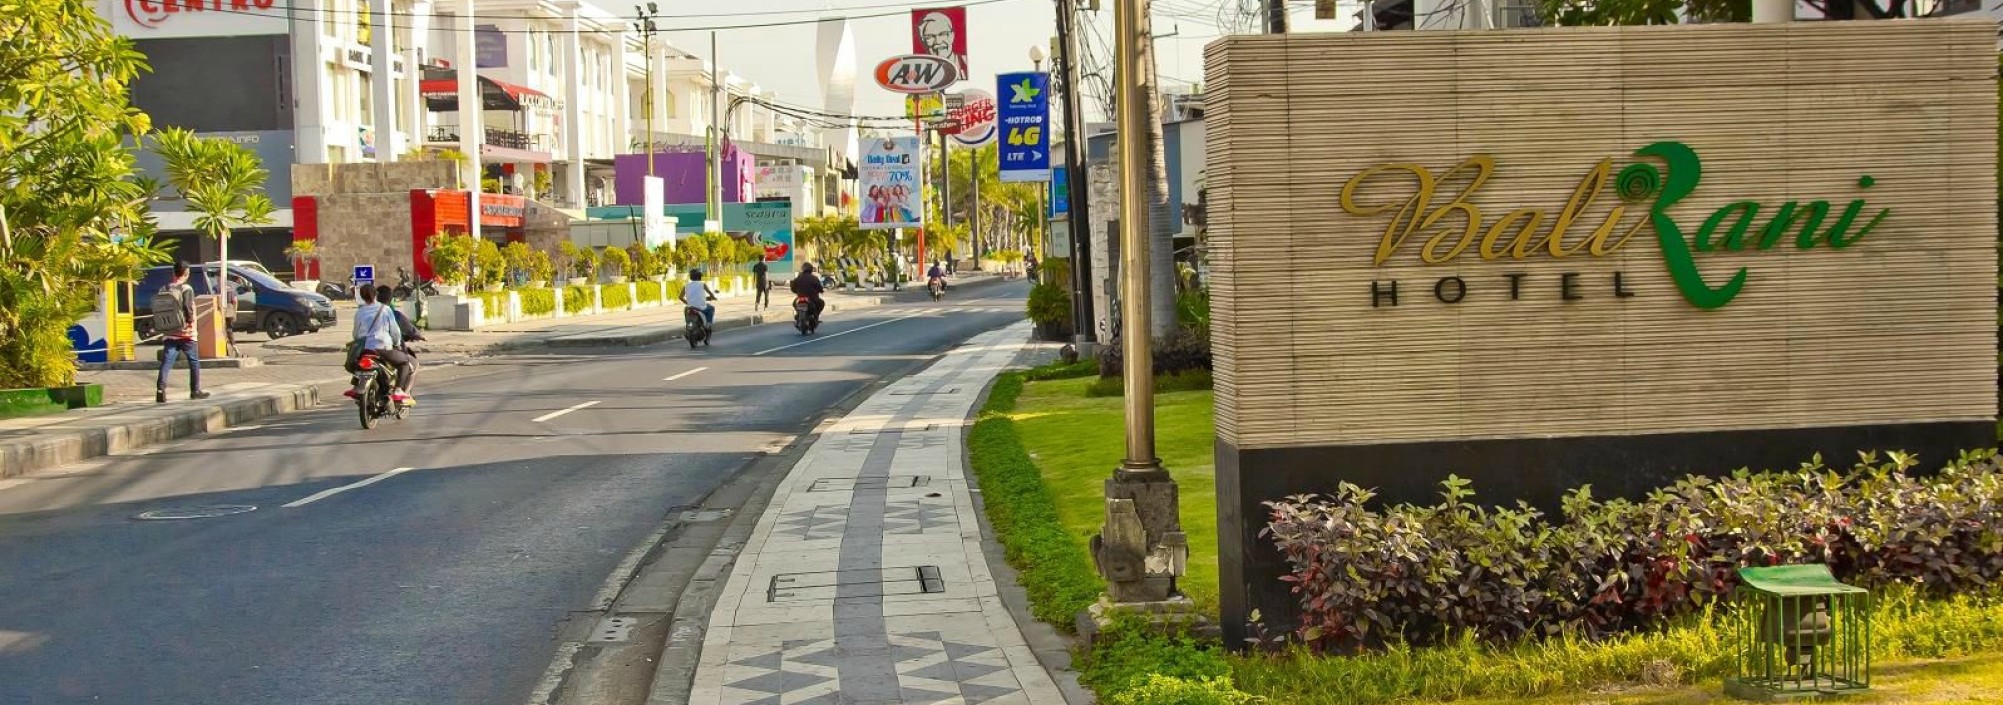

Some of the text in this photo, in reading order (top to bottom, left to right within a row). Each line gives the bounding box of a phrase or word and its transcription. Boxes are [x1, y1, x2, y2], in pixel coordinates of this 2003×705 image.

[889, 63, 943, 84] A&W
[1008, 127, 1040, 145] 4G
[1007, 152, 1025, 161] LTE
[889, 170, 913, 181] 70%
[1341, 141, 1890, 310] Bali Rani
[1371, 271, 1634, 308] HOTEL
